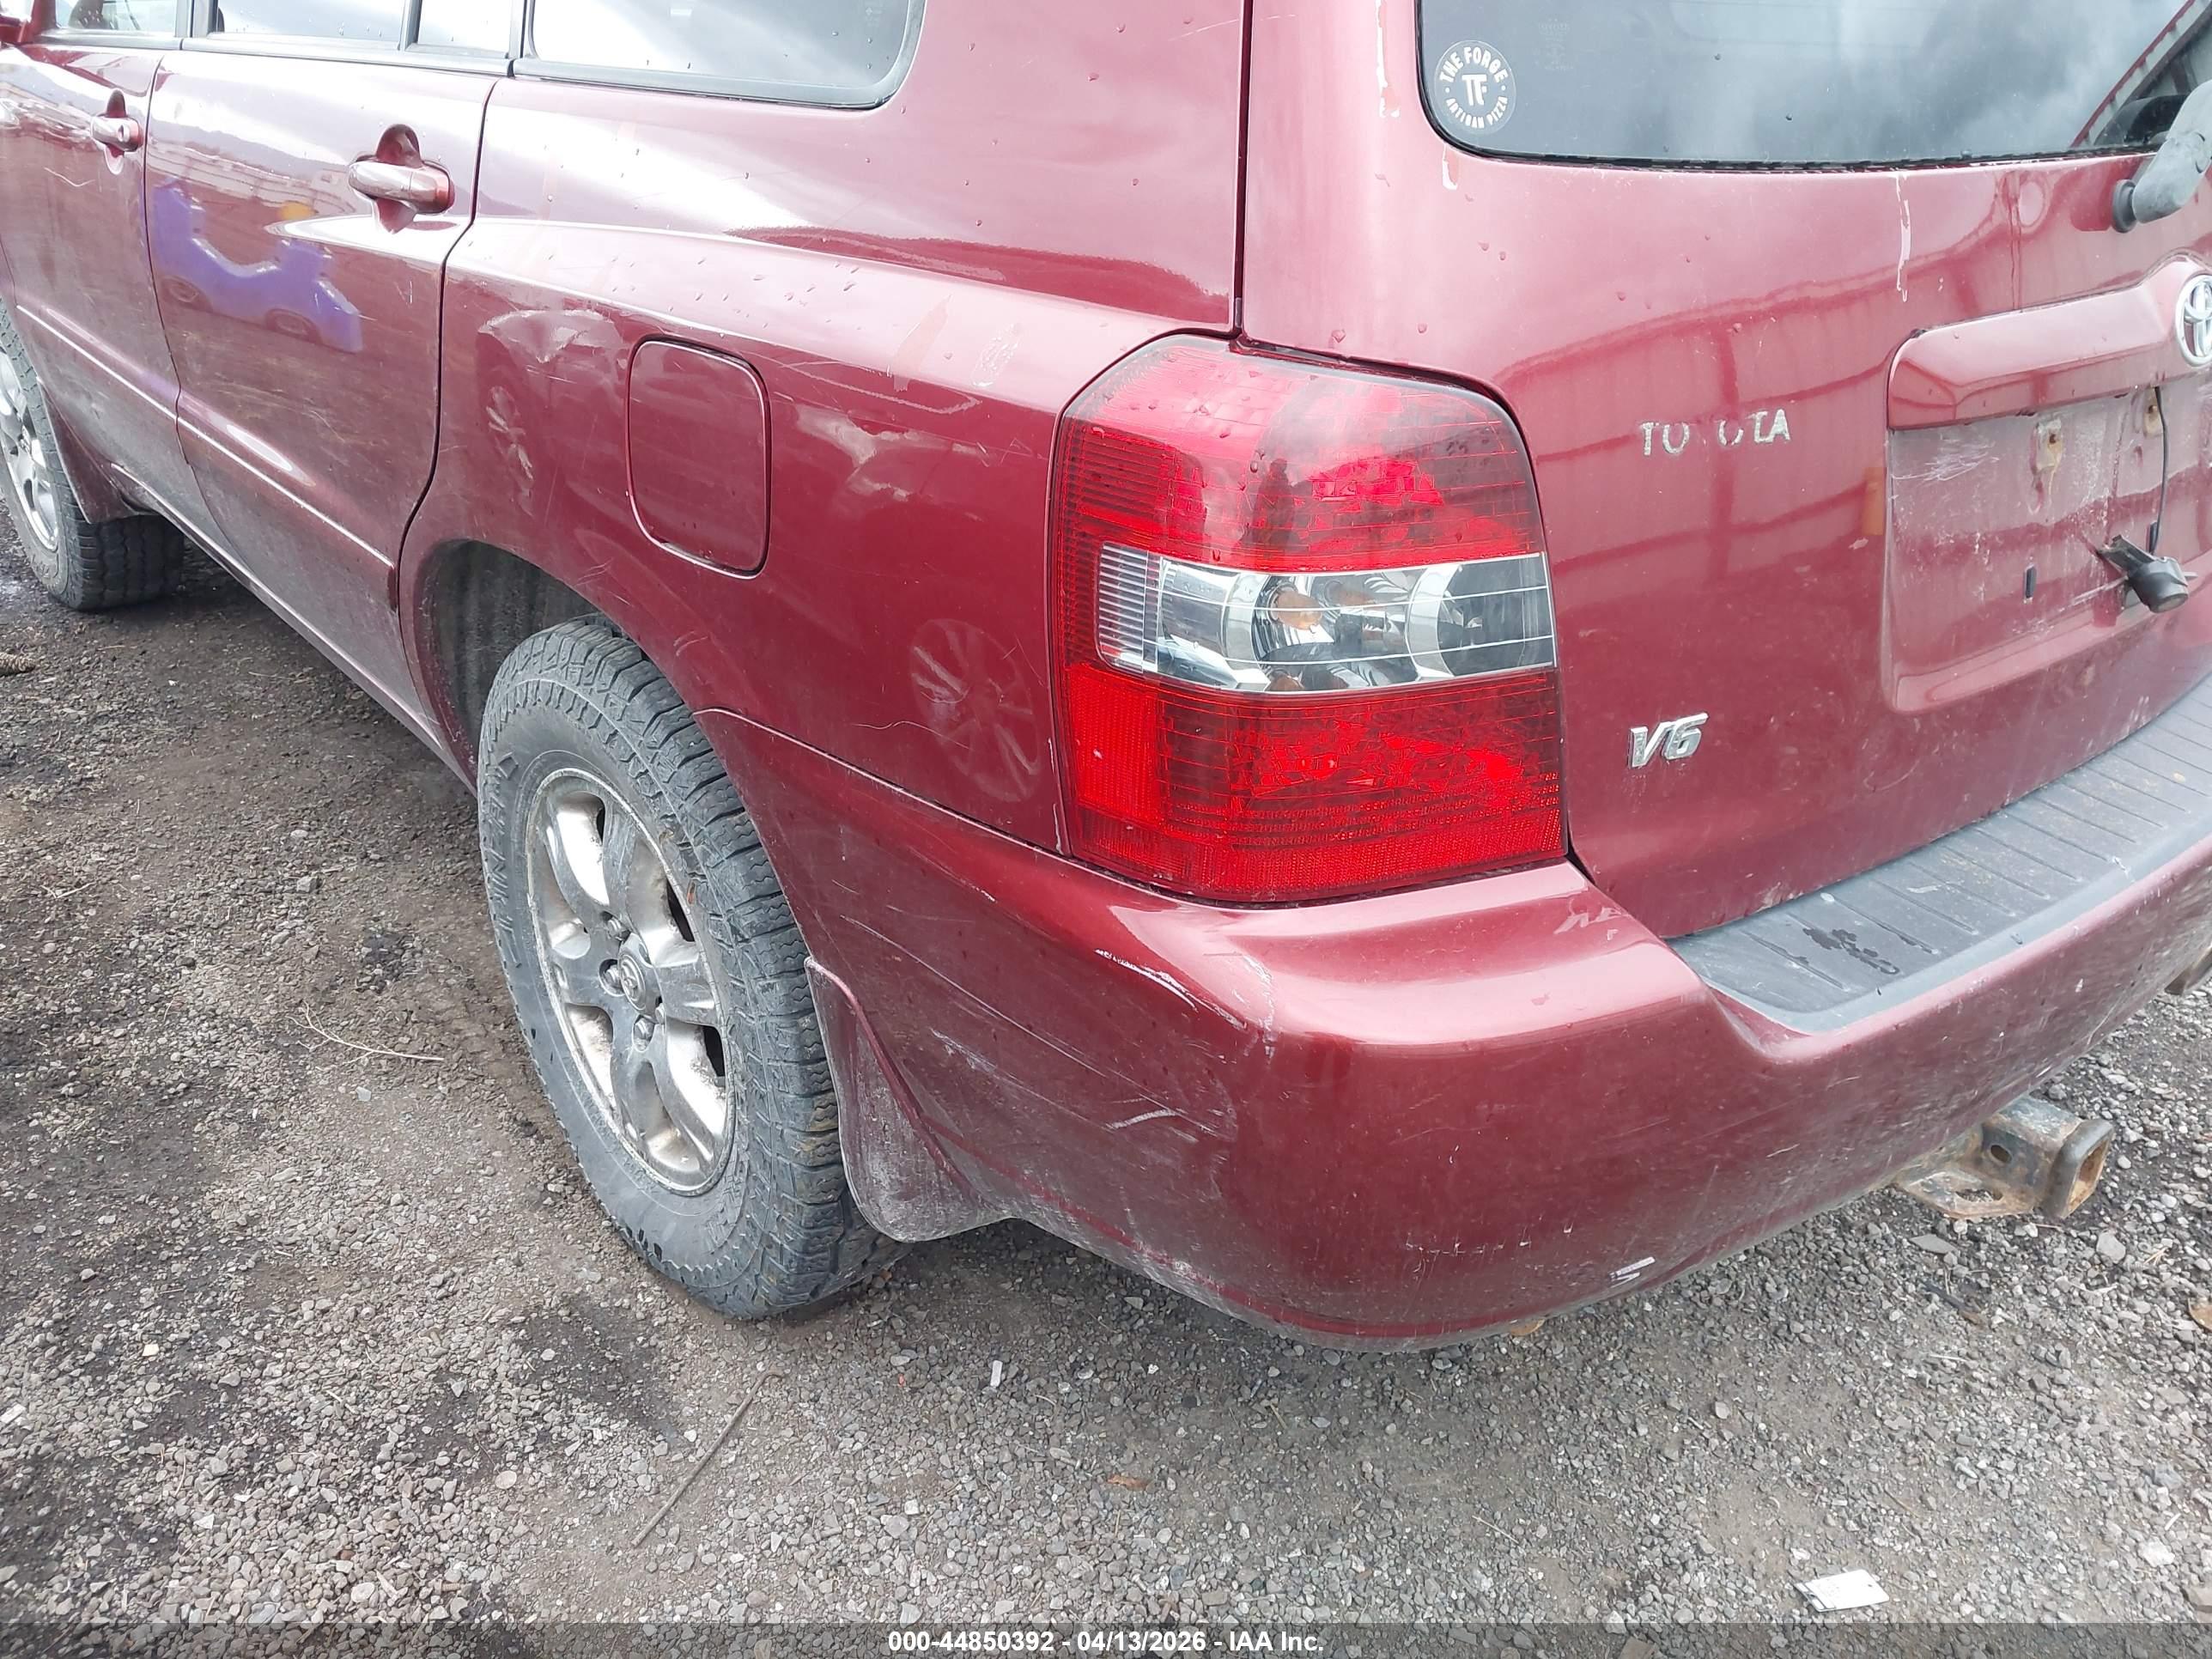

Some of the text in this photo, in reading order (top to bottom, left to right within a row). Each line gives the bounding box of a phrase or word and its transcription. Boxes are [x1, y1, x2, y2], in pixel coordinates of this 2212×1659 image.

[1439, 52, 1464, 82] THE
[1464, 46, 1509, 82] FORGE
[1446, 96, 1508, 128] ARTISAN PIZZA
[1628, 712, 1709, 769] V6
